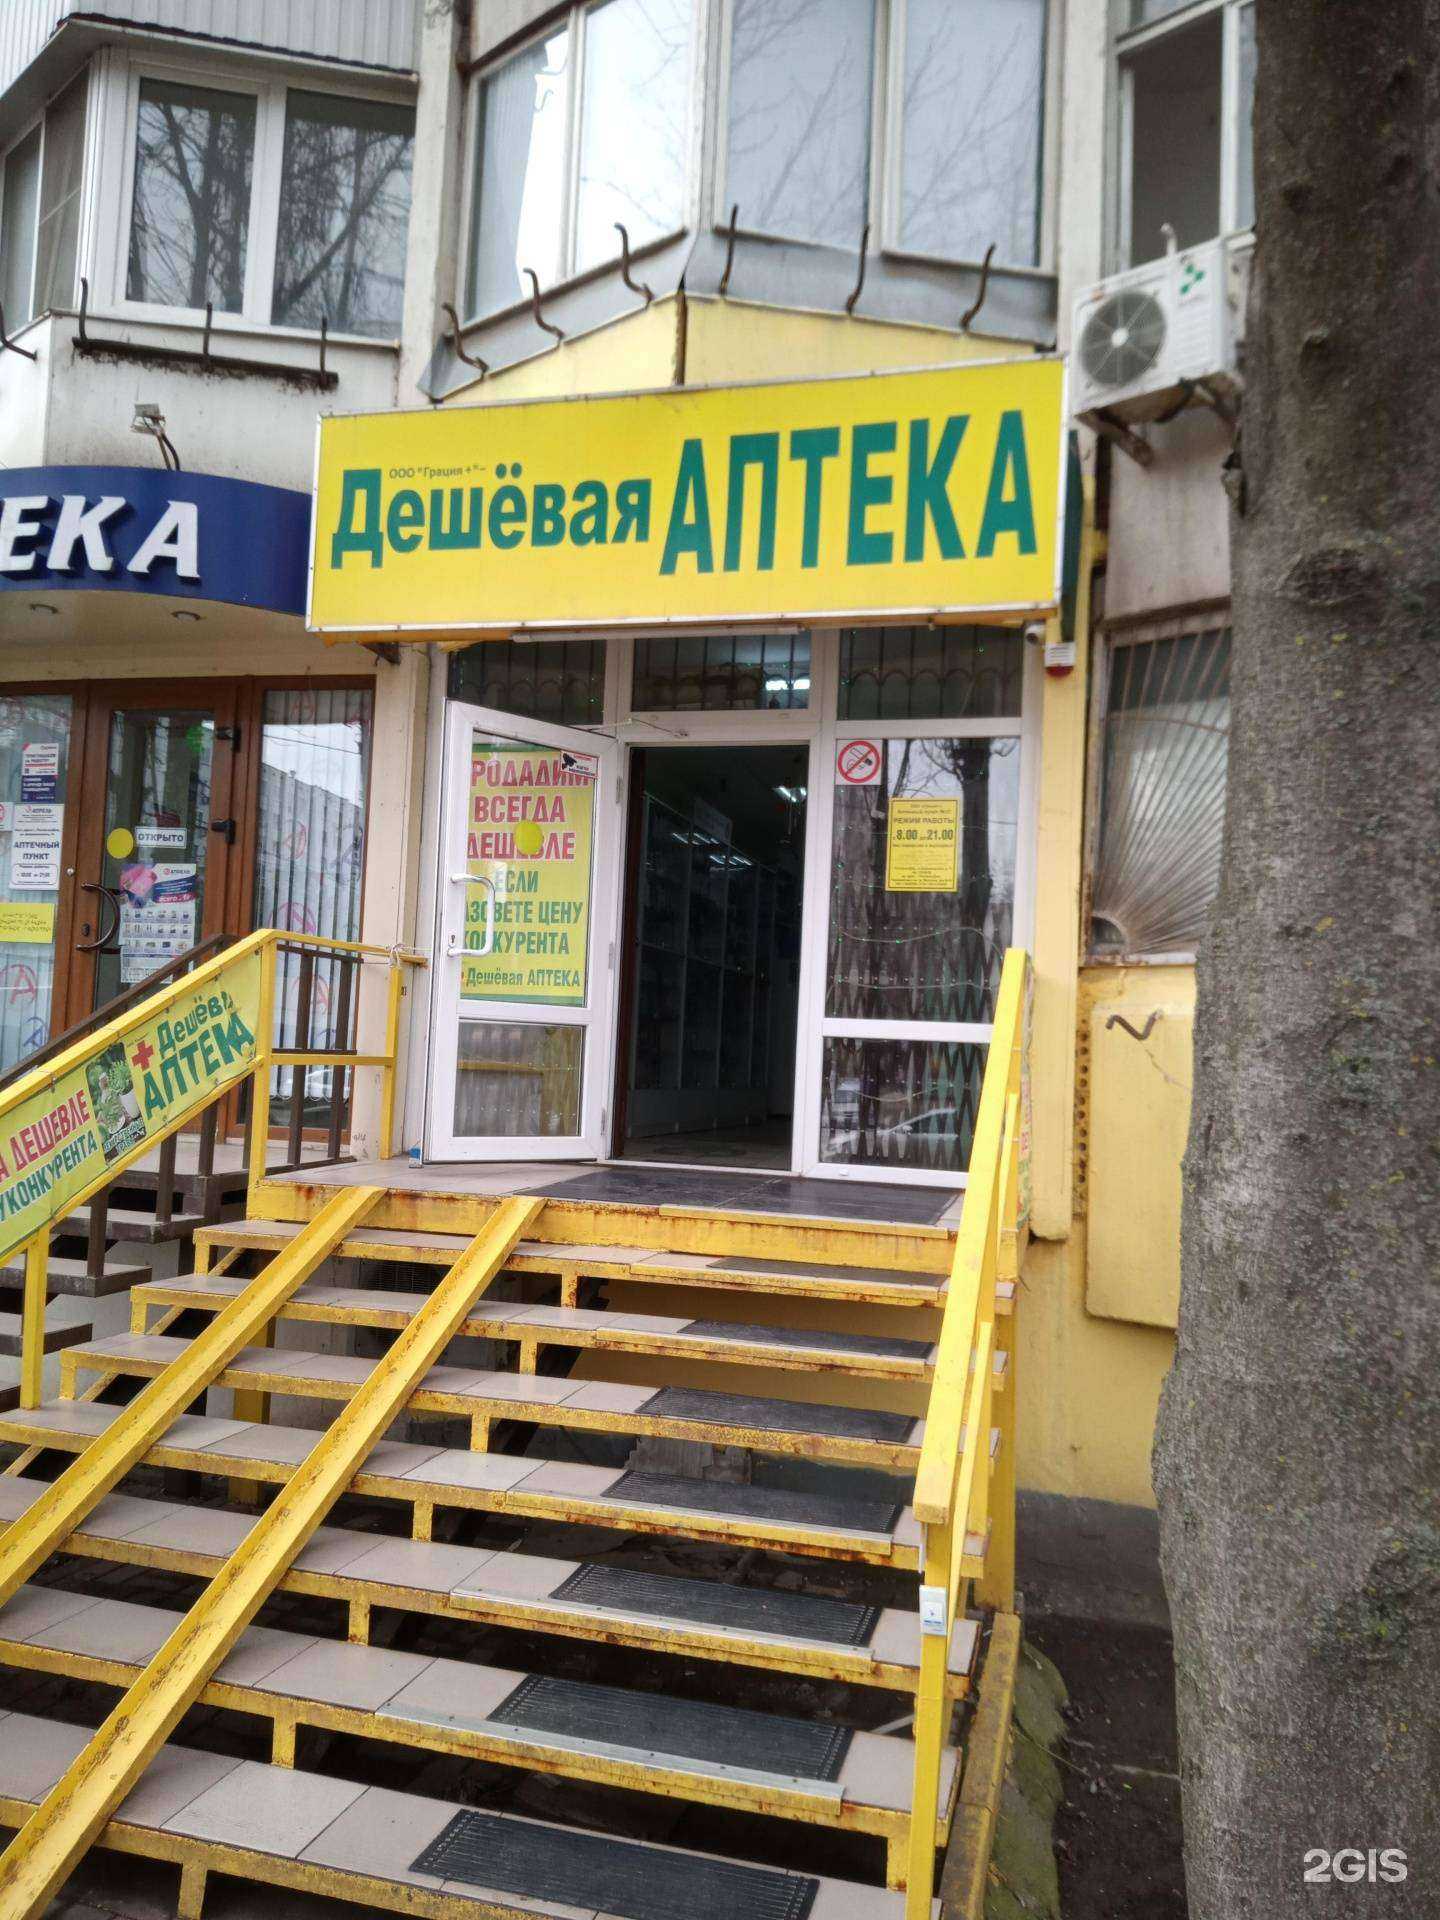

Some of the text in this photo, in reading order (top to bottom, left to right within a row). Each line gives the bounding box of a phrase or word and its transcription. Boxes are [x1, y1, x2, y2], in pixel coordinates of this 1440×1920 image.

[331, 410, 1038, 576] Дешёвая АПТЕКА
[0, 495, 200, 578] ЕКА
[474, 795, 566, 823] ВСЕГДА
[14, 841, 60, 849] АПТЕЧНЫЙ
[138, 832, 184, 843] ОТКРЫТО
[467, 832, 576, 859] ДЕШЛЕ
[538, 901, 583, 925] ЦЕНУ
[466, 967, 580, 987] Дешёвая АПТЕКА
[10, 1089, 90, 1171] ДЕШЕВЛЕ
[6, 1129, 97, 1215] КОНКУРЕНТА
